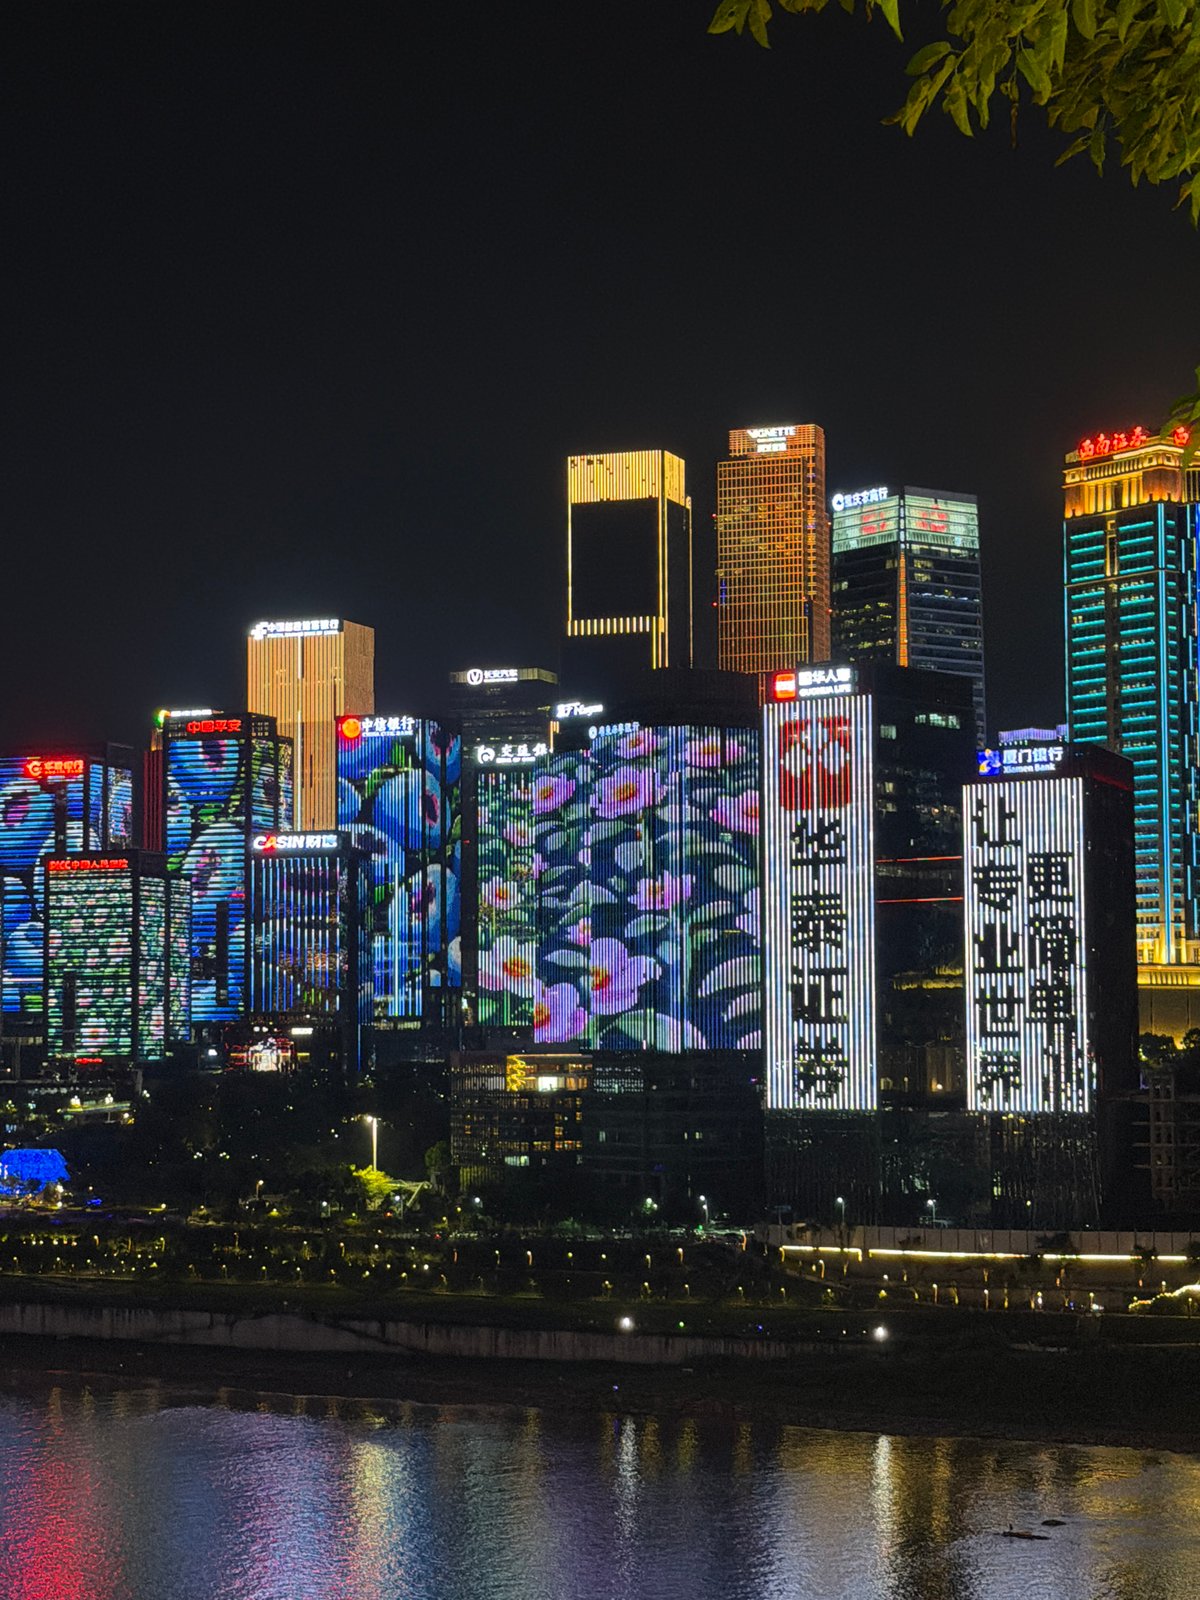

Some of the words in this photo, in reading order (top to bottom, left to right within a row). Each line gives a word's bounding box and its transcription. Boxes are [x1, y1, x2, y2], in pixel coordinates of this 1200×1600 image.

[1080, 426, 1147, 458] 西南证券
[186, 719, 242, 734] 中国平安
[362, 715, 415, 732] 中信银行
[501, 743, 550, 757] 交通银
[1003, 746, 1063, 764] 厦门银行
[1003, 765, 1034, 774] Xiamen
[1034, 762, 1056, 772] Bank
[253, 835, 304, 849] CASIN
[971, 796, 1024, 1104] 让专业世界
[1025, 852, 1076, 1046] 更简单
[790, 817, 849, 1100] 华泰证券
